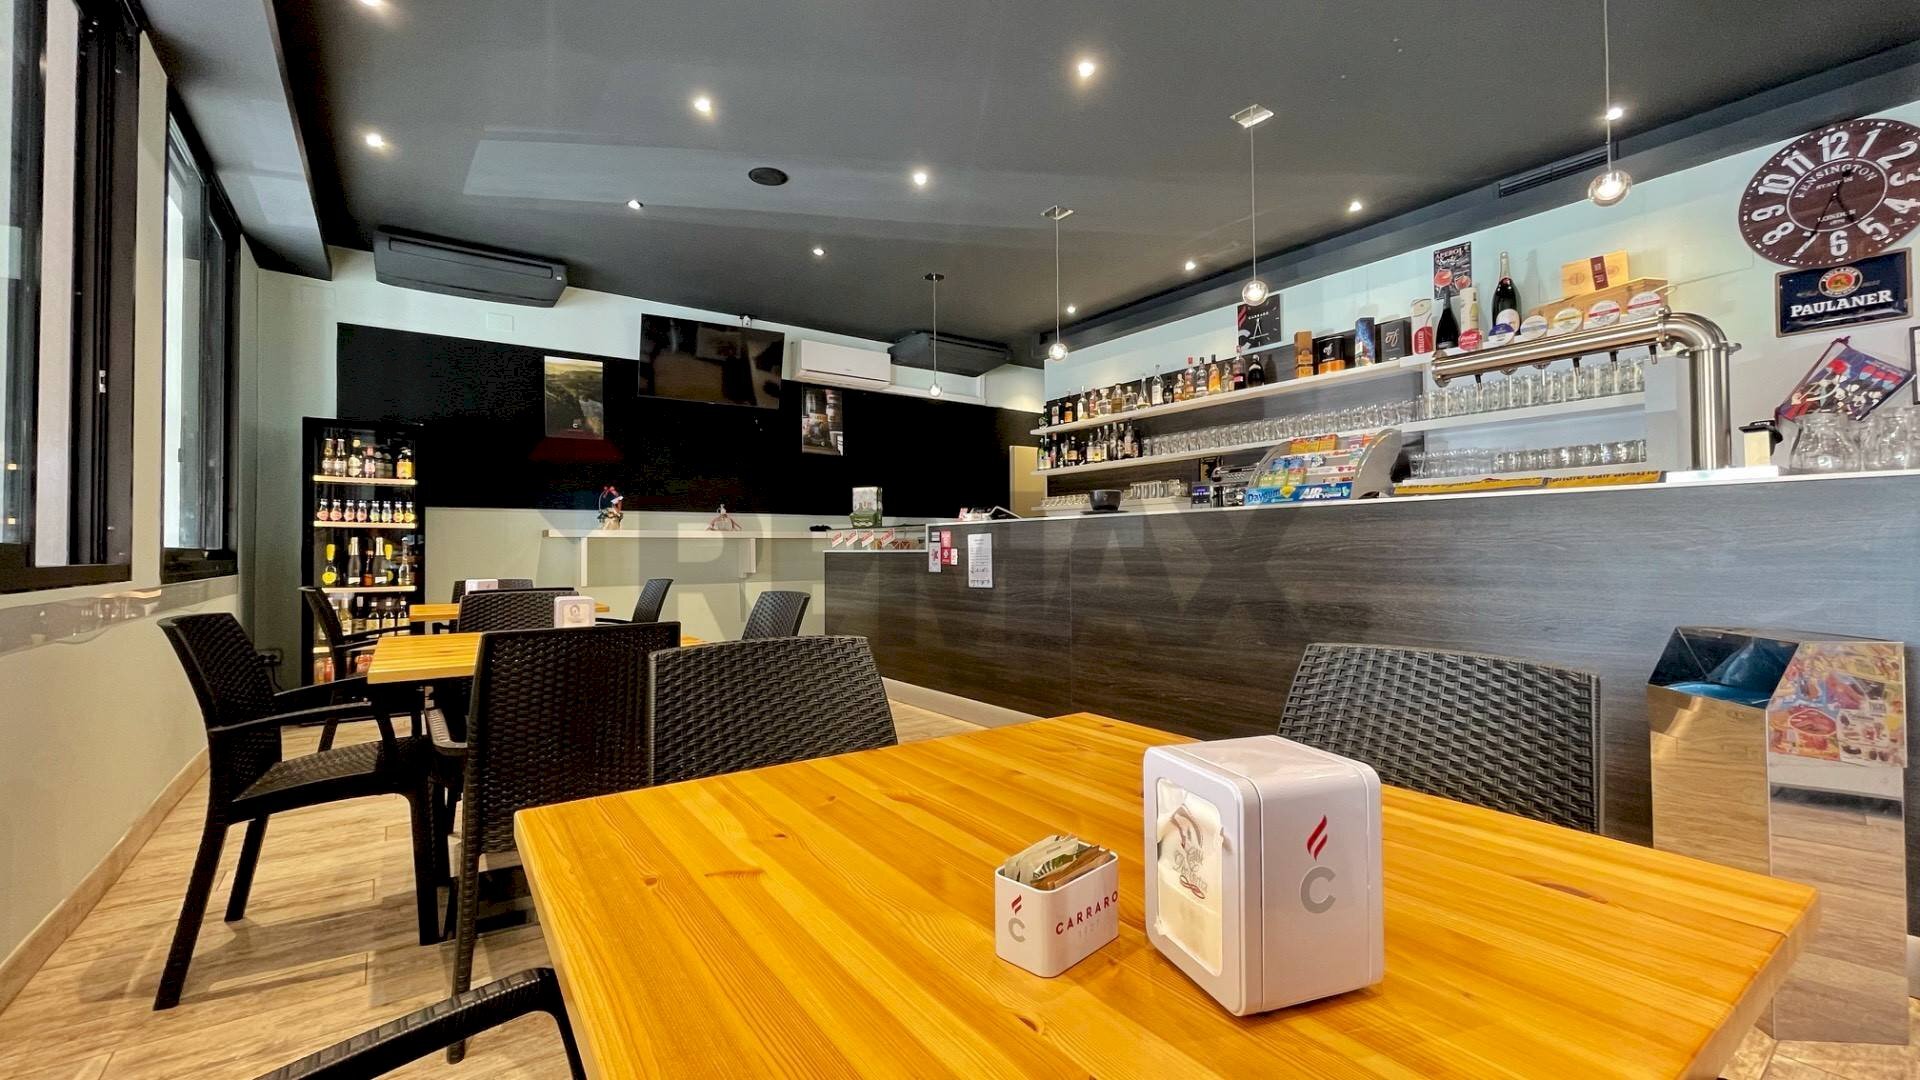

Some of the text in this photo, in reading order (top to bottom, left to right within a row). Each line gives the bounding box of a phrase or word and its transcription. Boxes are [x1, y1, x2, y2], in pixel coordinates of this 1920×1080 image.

[1818, 131, 1849, 162] 12
[1858, 129, 1882, 157] 1
[1876, 141, 1918, 169] 2
[1781, 150, 1815, 176] 11
[1758, 173, 1796, 196] 10
[1751, 204, 1785, 222] 9
[1884, 198, 1920, 214] 4
[1762, 222, 1795, 246] 8
[1857, 217, 1890, 241] 5
[1829, 230, 1849, 257] 6
[1790, 290, 1894, 317] PAULANER
[1300, 866, 1336, 914] C
[1056, 891, 1118, 935] CARRARO
